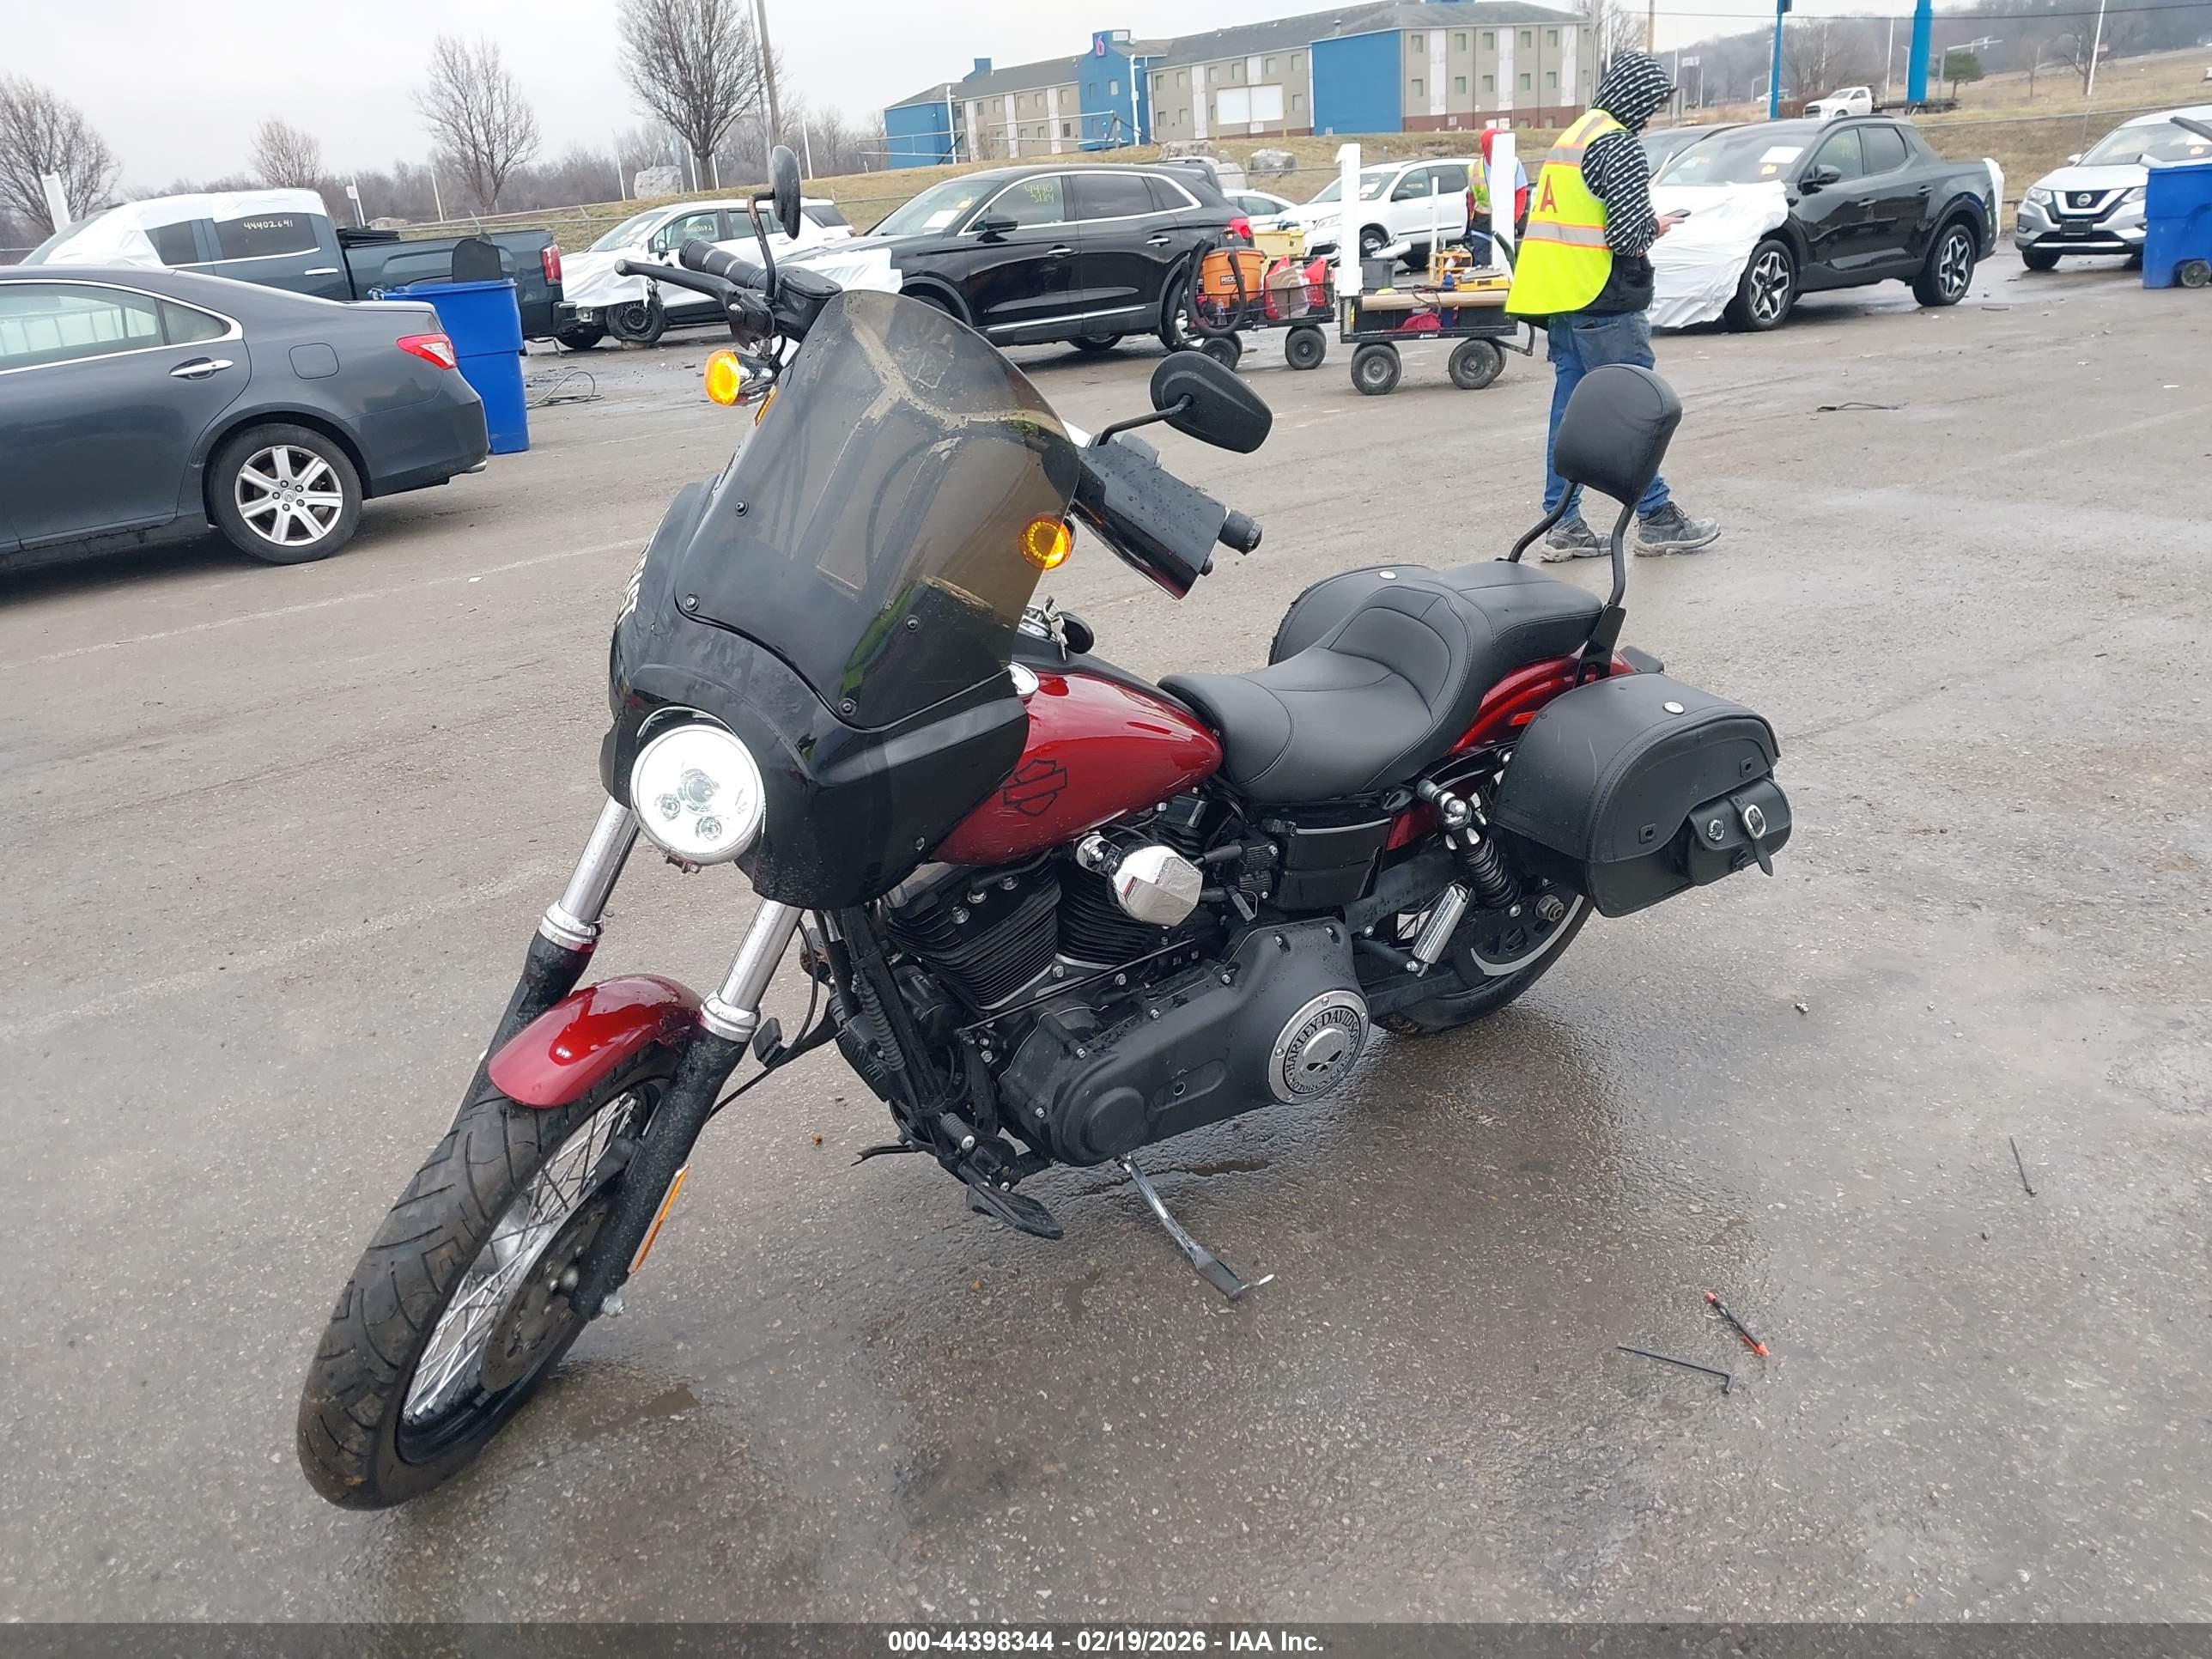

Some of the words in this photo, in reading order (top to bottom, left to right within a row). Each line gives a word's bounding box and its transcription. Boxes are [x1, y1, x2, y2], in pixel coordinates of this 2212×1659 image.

[1096, 34, 1105, 56] 6
[1533, 174, 1558, 213] A
[1285, 1009, 1360, 1073] HARLEY-DAVIDSON
